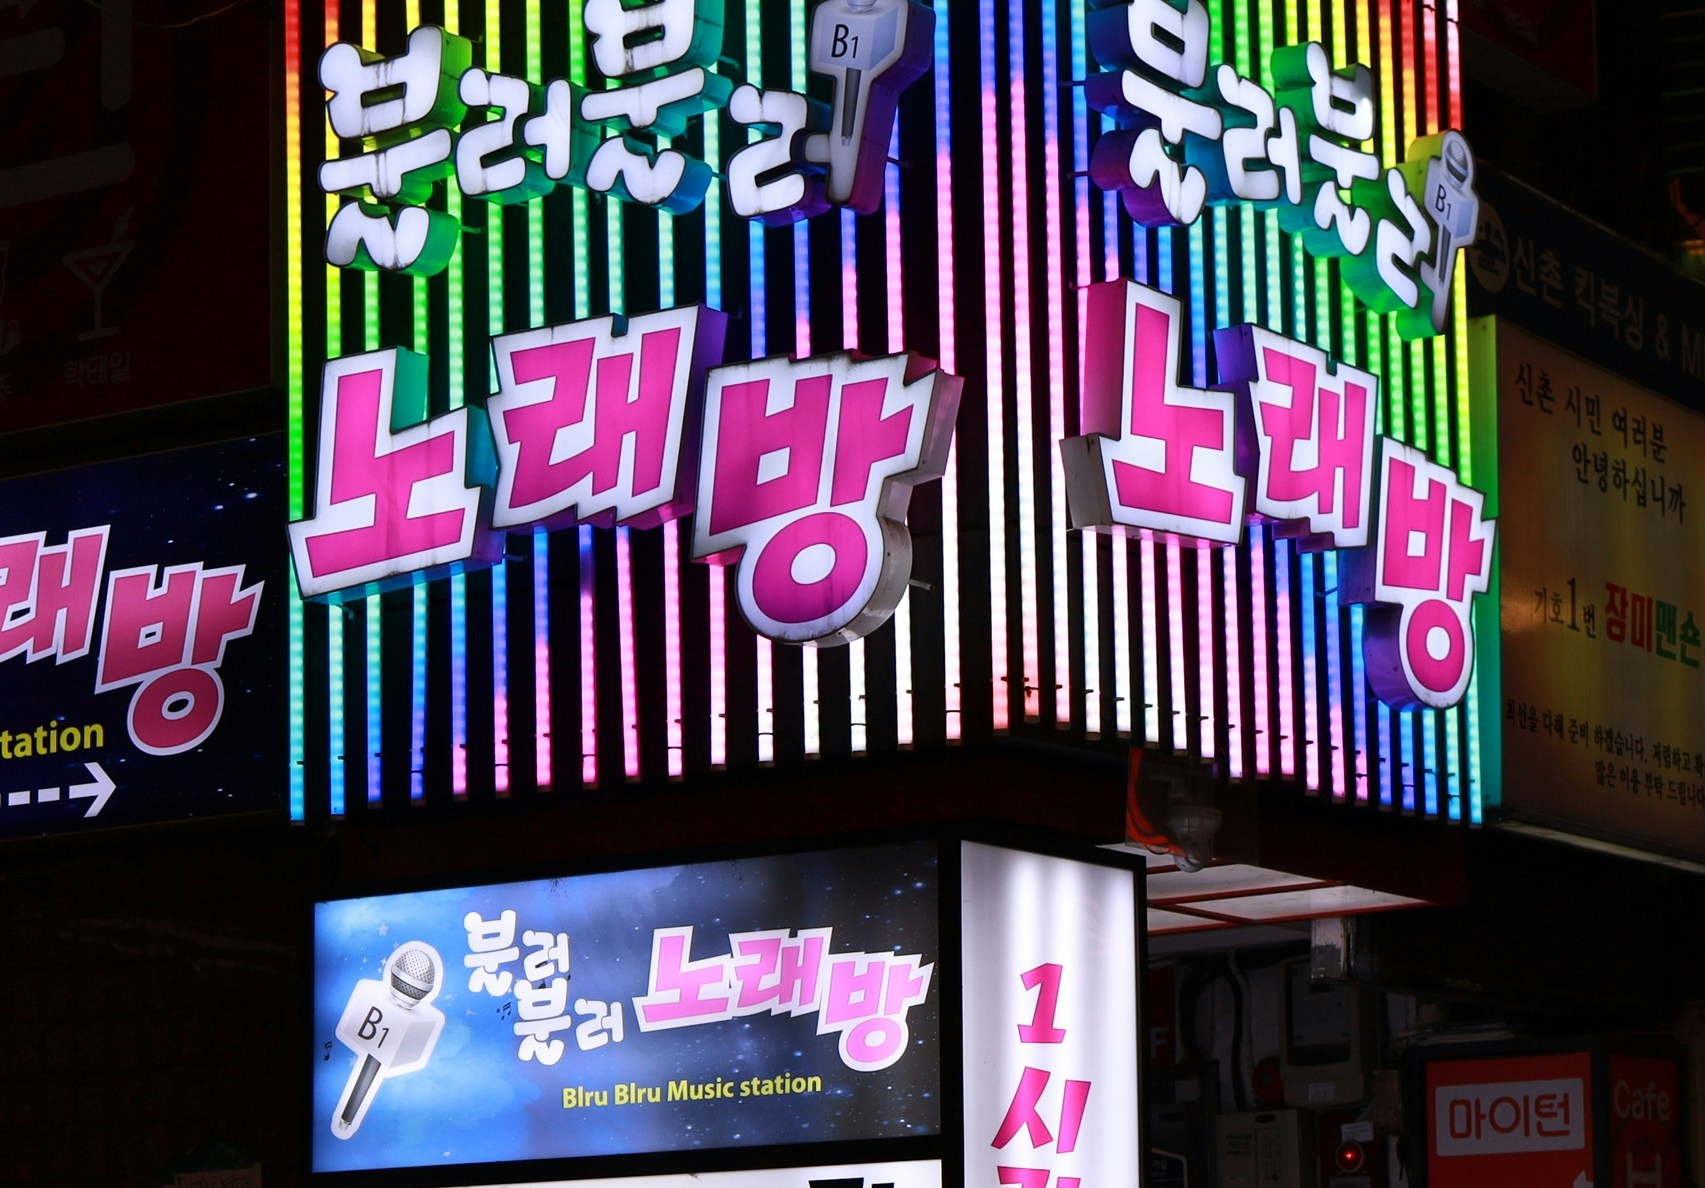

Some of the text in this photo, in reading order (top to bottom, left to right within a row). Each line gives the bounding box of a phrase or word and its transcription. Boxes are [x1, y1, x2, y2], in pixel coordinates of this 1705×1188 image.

[831, 23, 860, 60] B1
[1434, 184, 1453, 222] B1
[1511, 235, 1565, 310] 신촌
[1574, 265, 1646, 350] 킥복싱
[1655, 313, 1672, 362] &
[1513, 363, 1668, 464] 신촌 시민 여러분
[288, 303, 938, 648] 노래방
[1099, 277, 1497, 708] 노래방
[1572, 442, 1687, 524] 안녕하십니까
[1604, 581, 1701, 668] 장미맨숀
[1505, 699, 1539, 733] 최선을
[1542, 710, 1565, 740] 다해
[1568, 718, 1590, 748] 준비
[1593, 725, 1648, 764] 하겠습니다.
[1652, 741, 1692, 772] 저렴하고
[1619, 766, 1641, 794] 이용
[1644, 772, 1665, 800] 부탁
[464, 909, 571, 997] 불러
[357, 1005, 390, 1050] B1
[513, 980, 624, 1066] 불러
[632, 926, 934, 1072] 노래방
[667, 1077, 734, 1103] Music
[739, 1072, 822, 1099] station
[1448, 1091, 1572, 1141] 마이턴
[1612, 1077, 1671, 1123] Cafe
